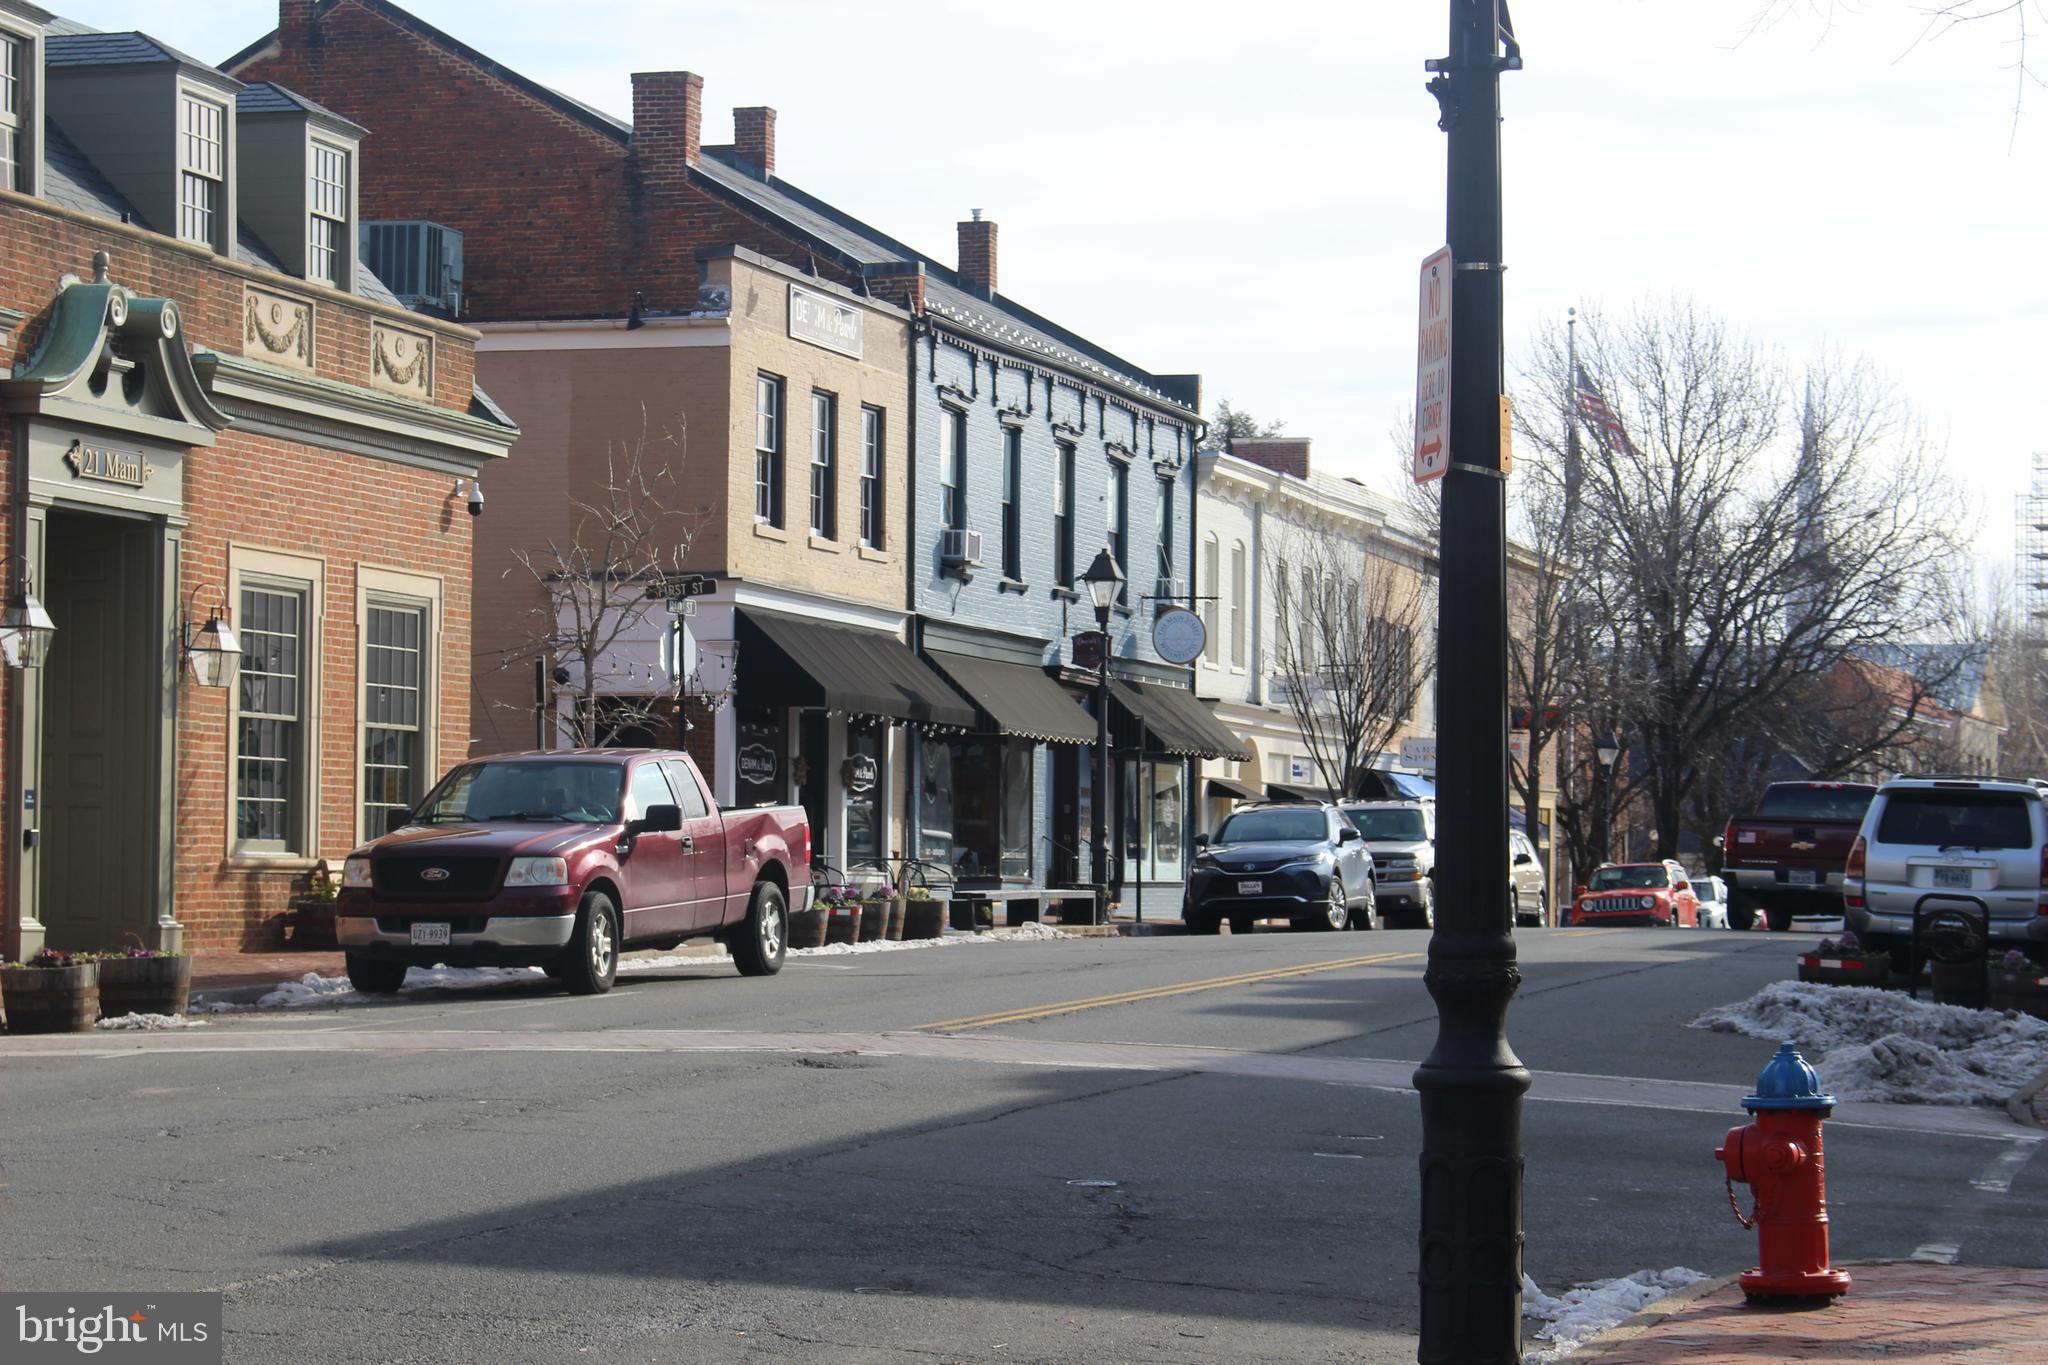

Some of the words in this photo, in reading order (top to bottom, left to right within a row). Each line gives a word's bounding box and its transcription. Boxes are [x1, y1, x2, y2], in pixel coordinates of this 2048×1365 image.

[1429, 277, 1440, 320] NO
[1421, 318, 1447, 367] PARKING
[1437, 367, 1445, 396] TO
[1423, 401, 1441, 433] CORNER
[83, 448, 99, 475] 21
[105, 452, 139, 481] Main
[656, 582, 687, 598] FIRST
[692, 582, 704, 595] ST
